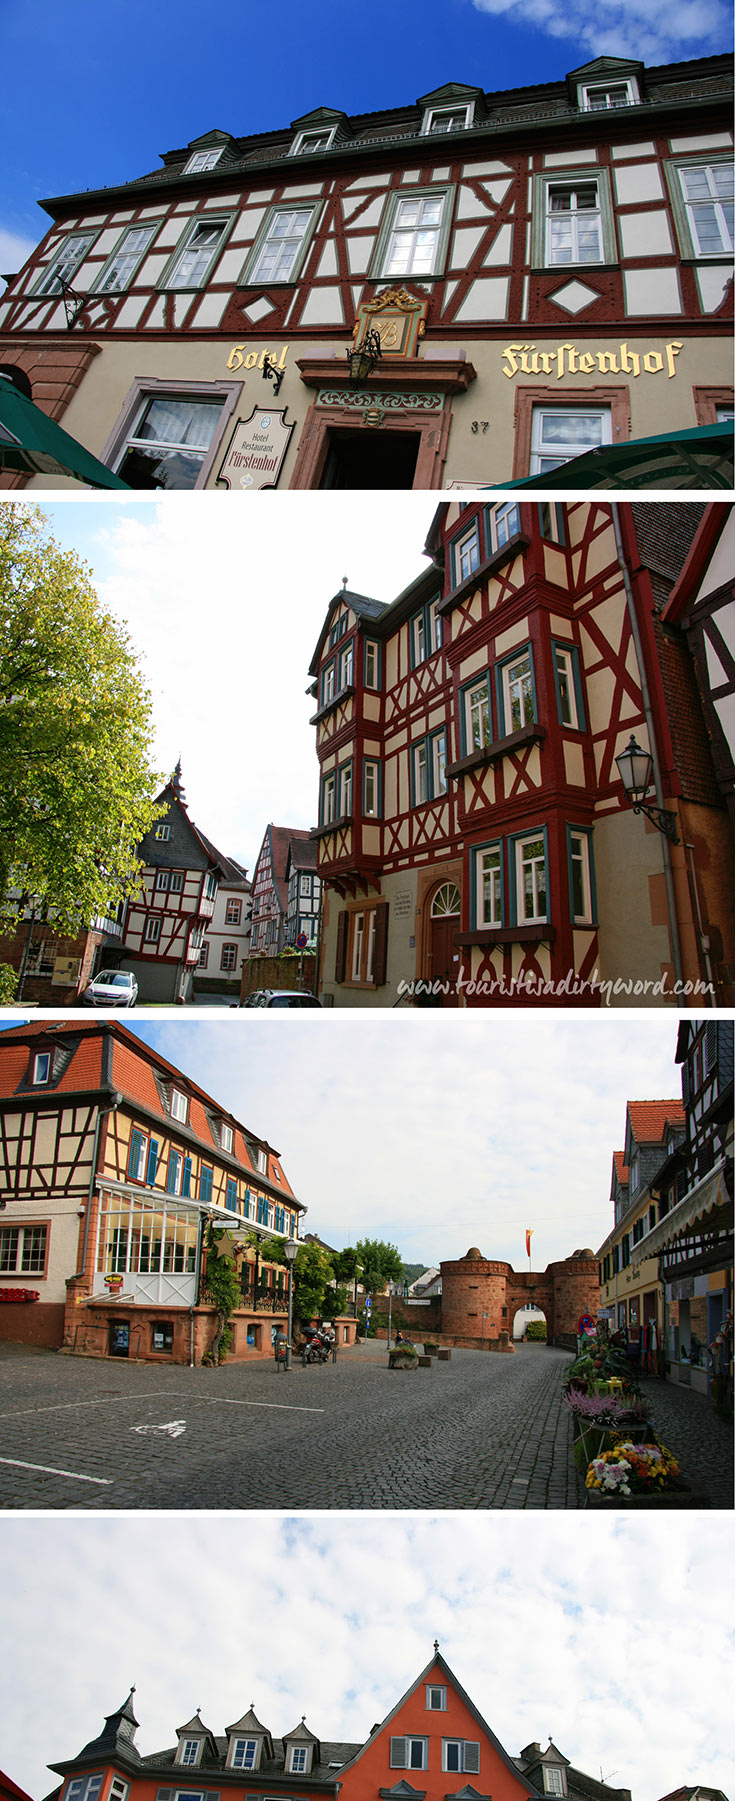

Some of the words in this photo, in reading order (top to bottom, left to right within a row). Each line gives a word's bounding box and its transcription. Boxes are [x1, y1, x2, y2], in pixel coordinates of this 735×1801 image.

[226, 345, 290, 373] Hotel
[252, 432, 269, 443] Hotel
[241, 441, 274, 453] Restaurant
[228, 450, 279, 472] Fürstenhof
